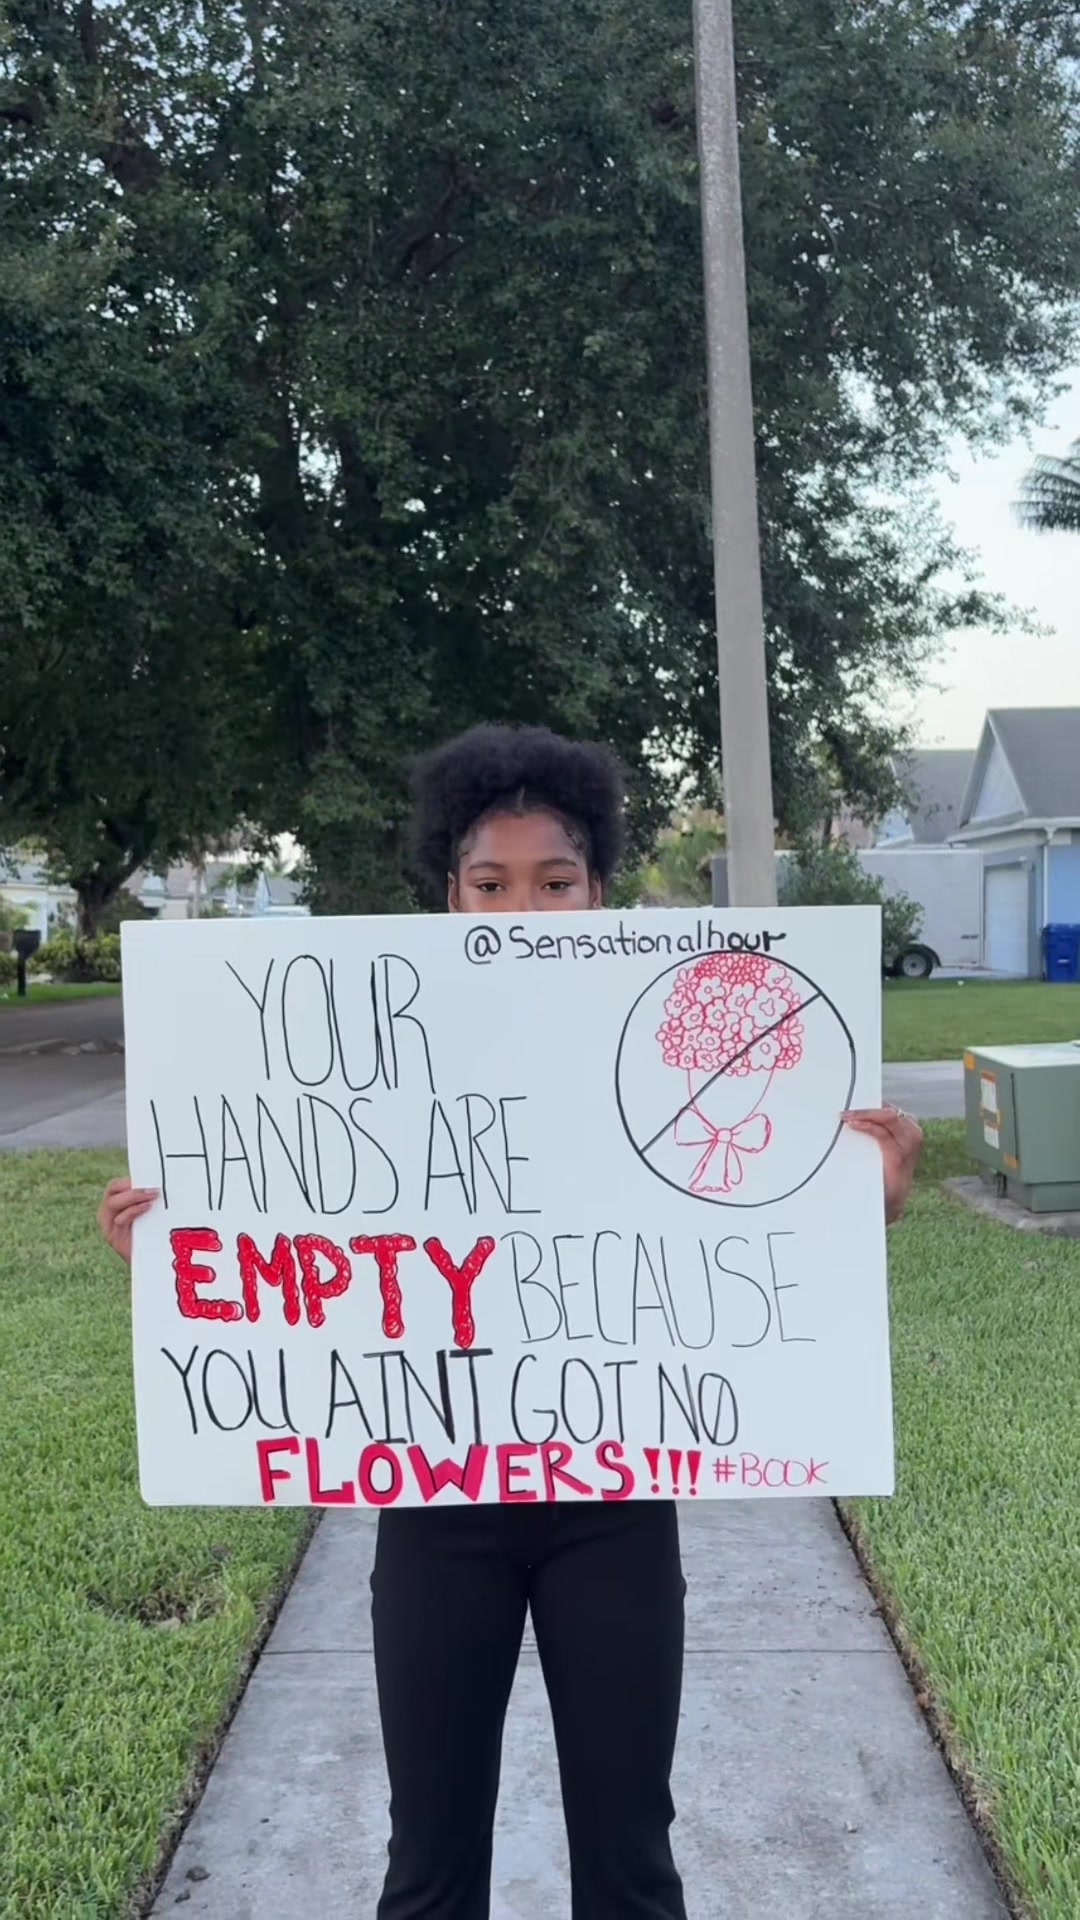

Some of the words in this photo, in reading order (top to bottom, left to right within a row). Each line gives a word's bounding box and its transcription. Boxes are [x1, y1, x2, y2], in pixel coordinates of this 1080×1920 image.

[224, 953, 436, 1094] YOUR
[149, 1093, 400, 1215] HANDS
[424, 1093, 542, 1215] ARE
[169, 1226, 496, 1349] EMPTY
[499, 1230, 817, 1350] BECAUSE
[160, 1344, 301, 1435] YOU
[325, 1347, 493, 1446] AINT
[510, 1353, 639, 1446] GOT
[255, 1436, 702, 1505] FLOWERS!!!
